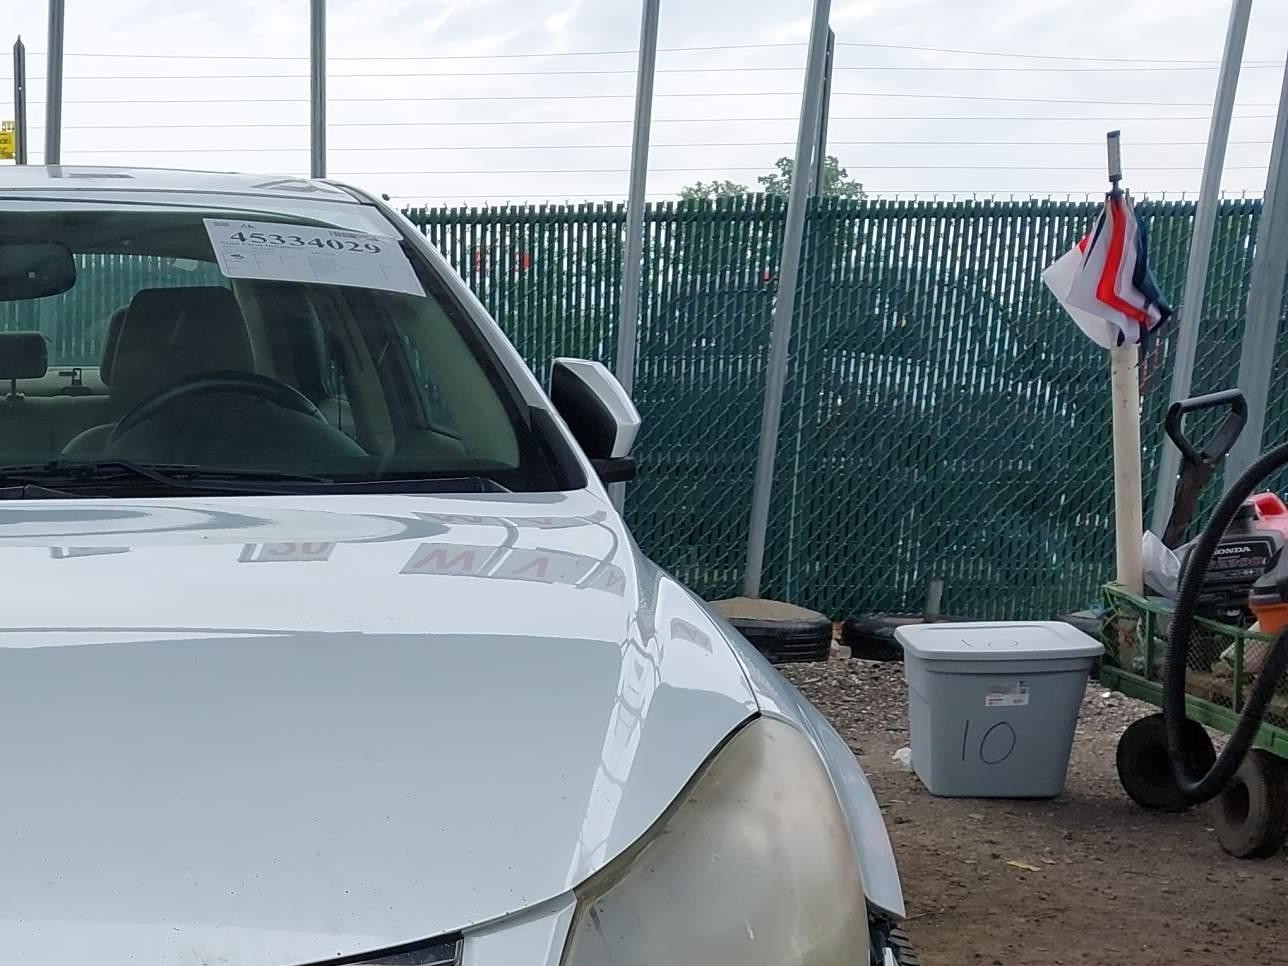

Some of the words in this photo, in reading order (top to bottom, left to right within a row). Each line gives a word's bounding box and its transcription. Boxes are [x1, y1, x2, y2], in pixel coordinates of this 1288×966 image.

[229, 231, 383, 255] 45334029
[1214, 546, 1253, 556] ONDA
[960, 719, 1017, 765] 10
